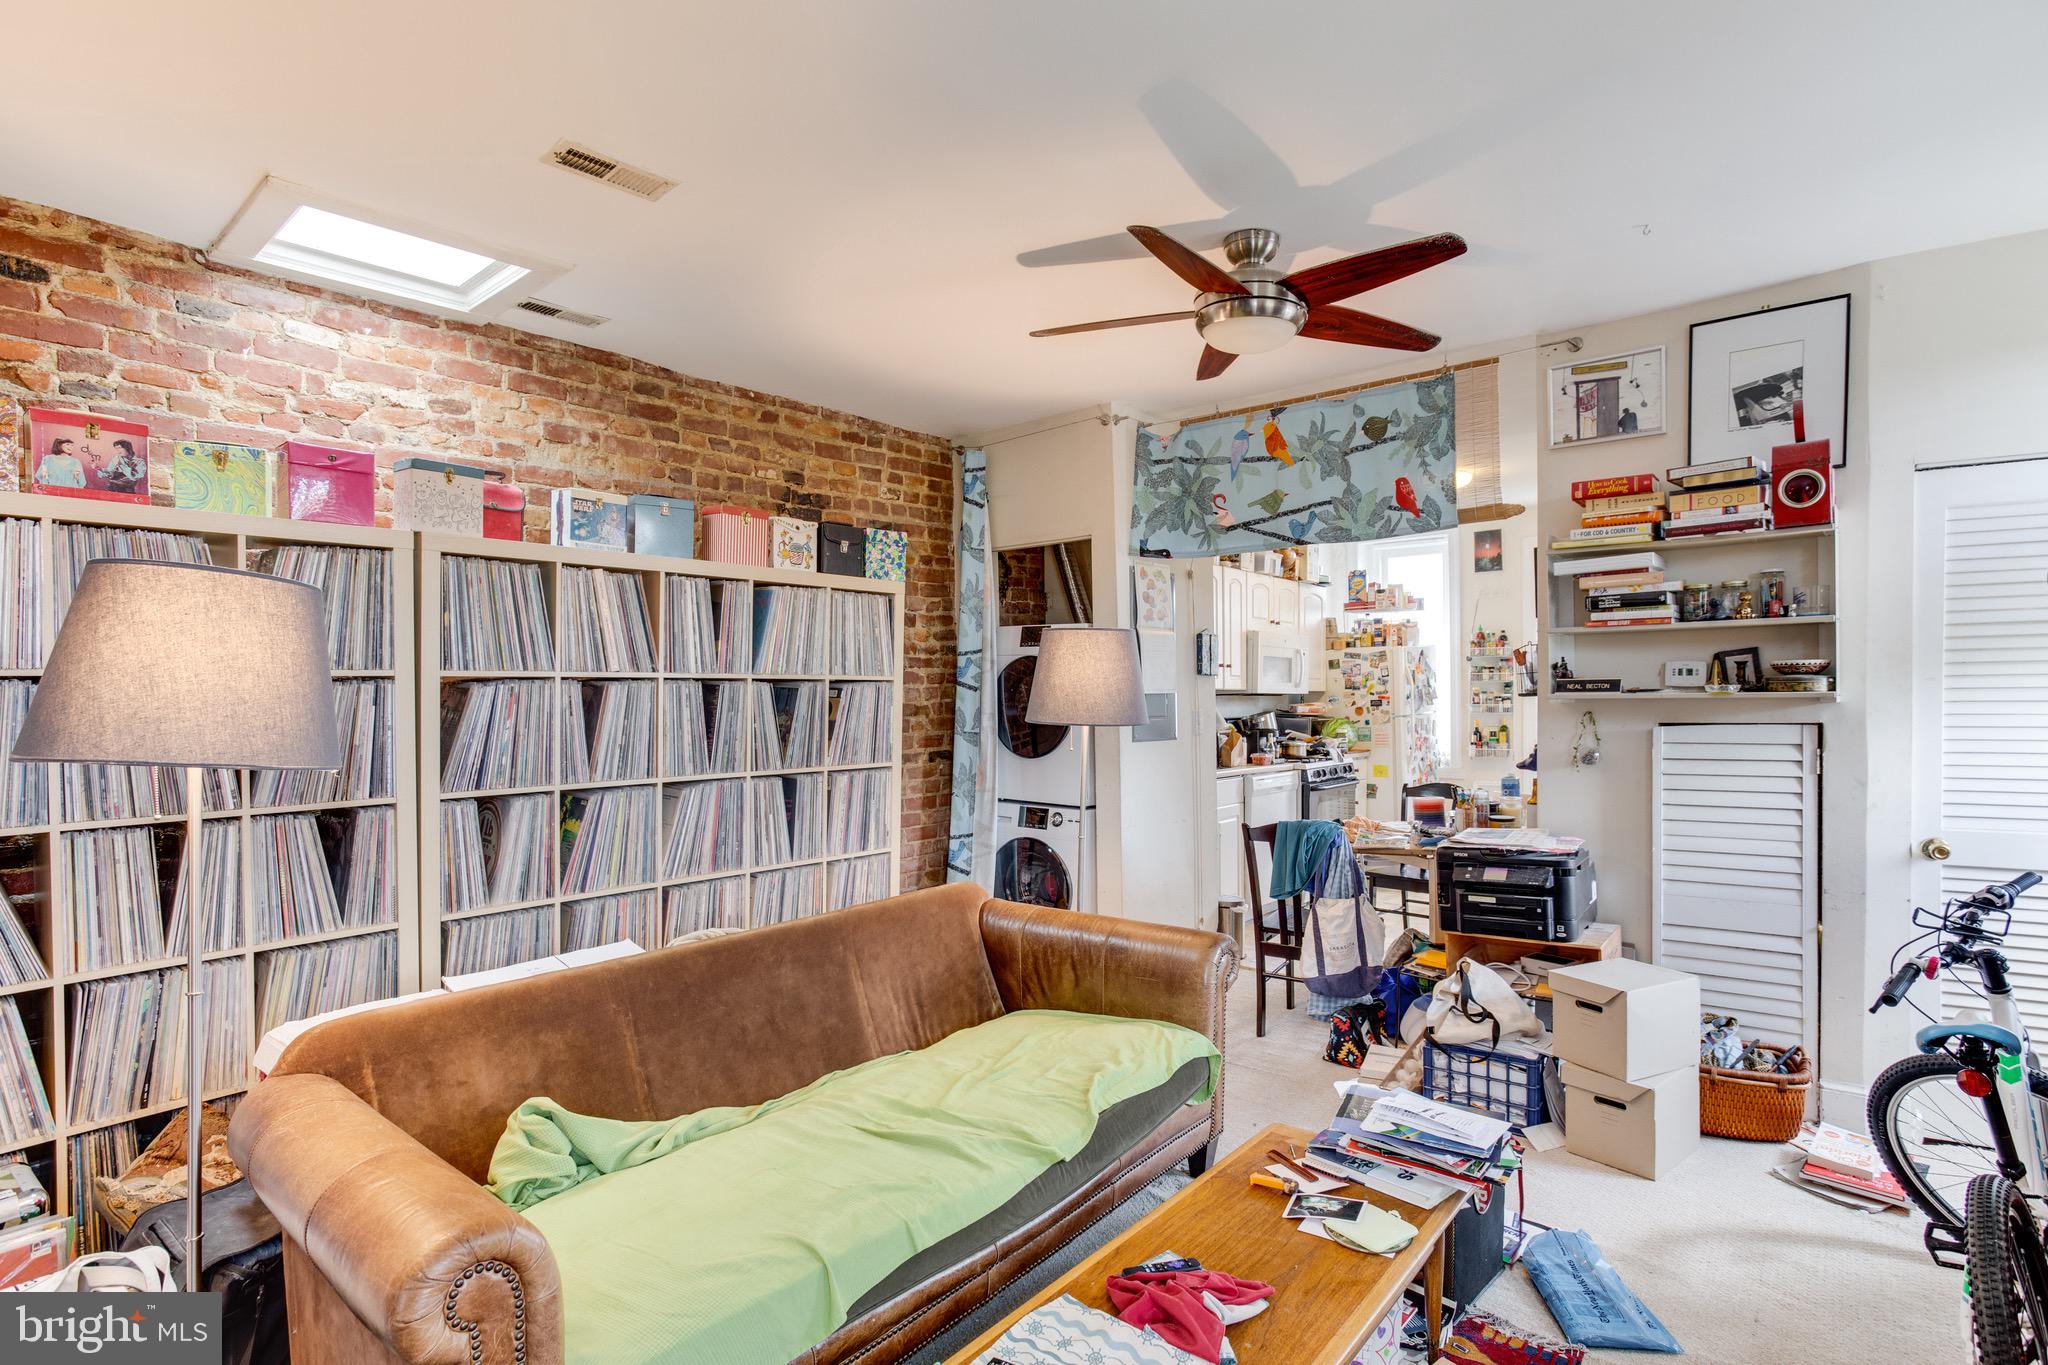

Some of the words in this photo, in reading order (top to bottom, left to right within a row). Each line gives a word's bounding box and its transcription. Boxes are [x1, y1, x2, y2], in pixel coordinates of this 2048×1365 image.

[1588, 484, 1629, 496] Everything
[573, 499, 593, 507] STAR
[1697, 494, 1745, 506] FOOD
[573, 504, 594, 513] WARS
[1610, 526, 1637, 535] COUNTRY
